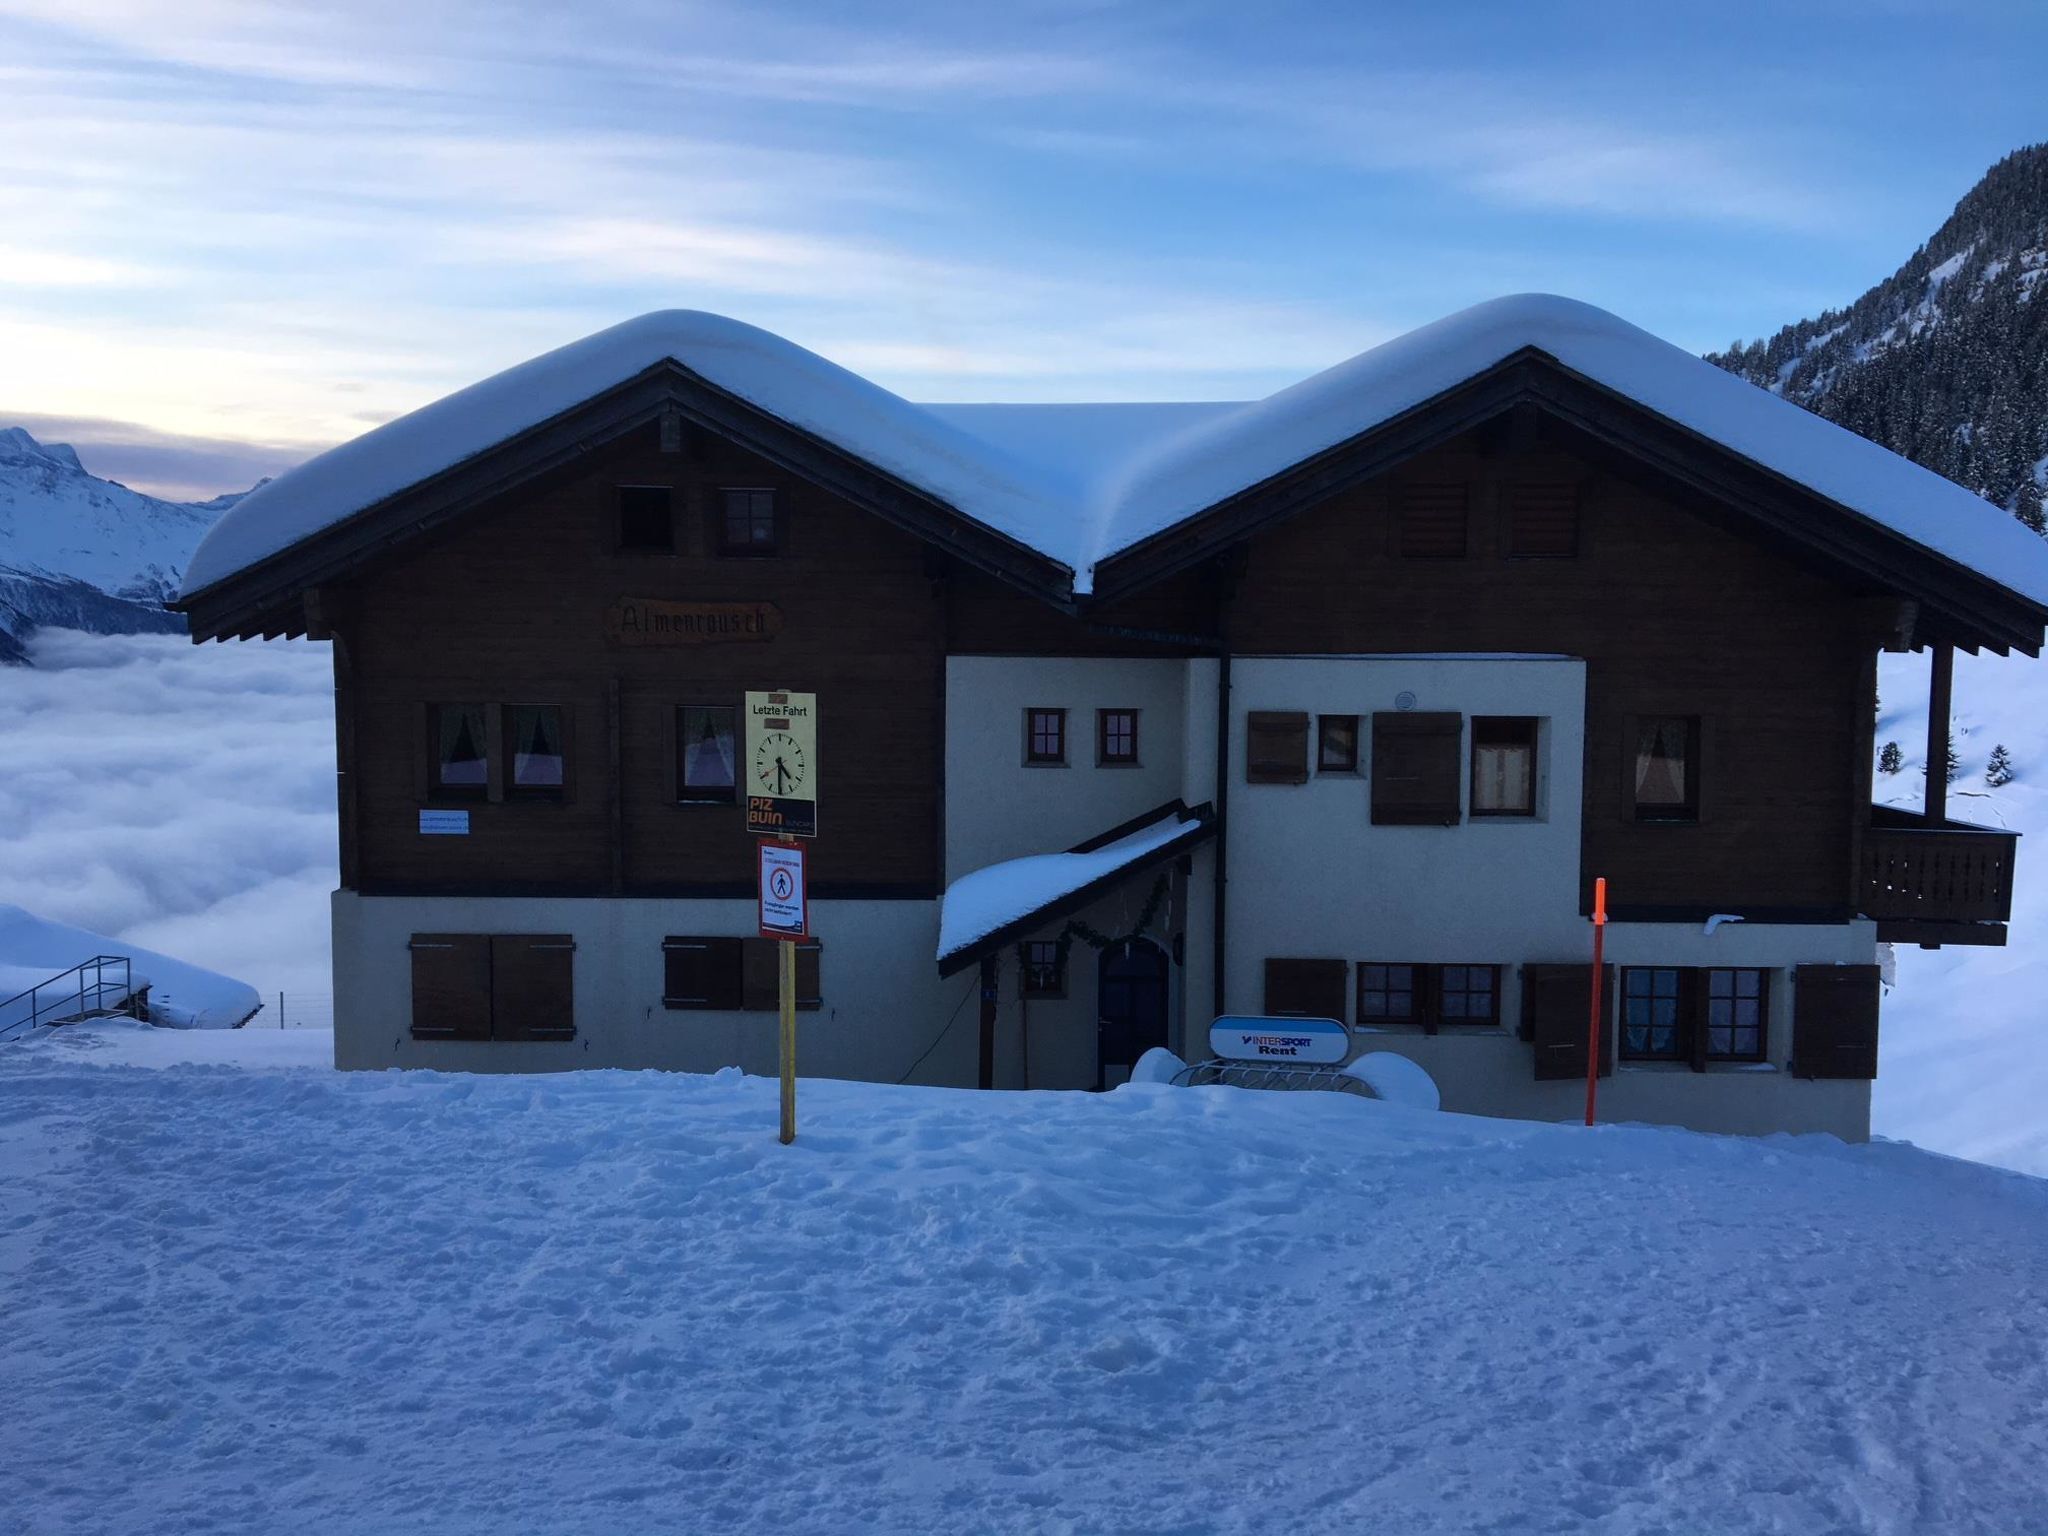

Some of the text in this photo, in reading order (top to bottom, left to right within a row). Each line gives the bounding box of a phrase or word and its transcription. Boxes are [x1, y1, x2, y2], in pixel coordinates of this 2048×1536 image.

[622, 605, 766, 633] Almenrausch
[753, 704, 807, 716] Letzte Fahrt
[750, 798, 773, 811] PIZ
[1253, 1036, 1312, 1047] INTERSPORT
[1259, 1045, 1297, 1056] Rent
